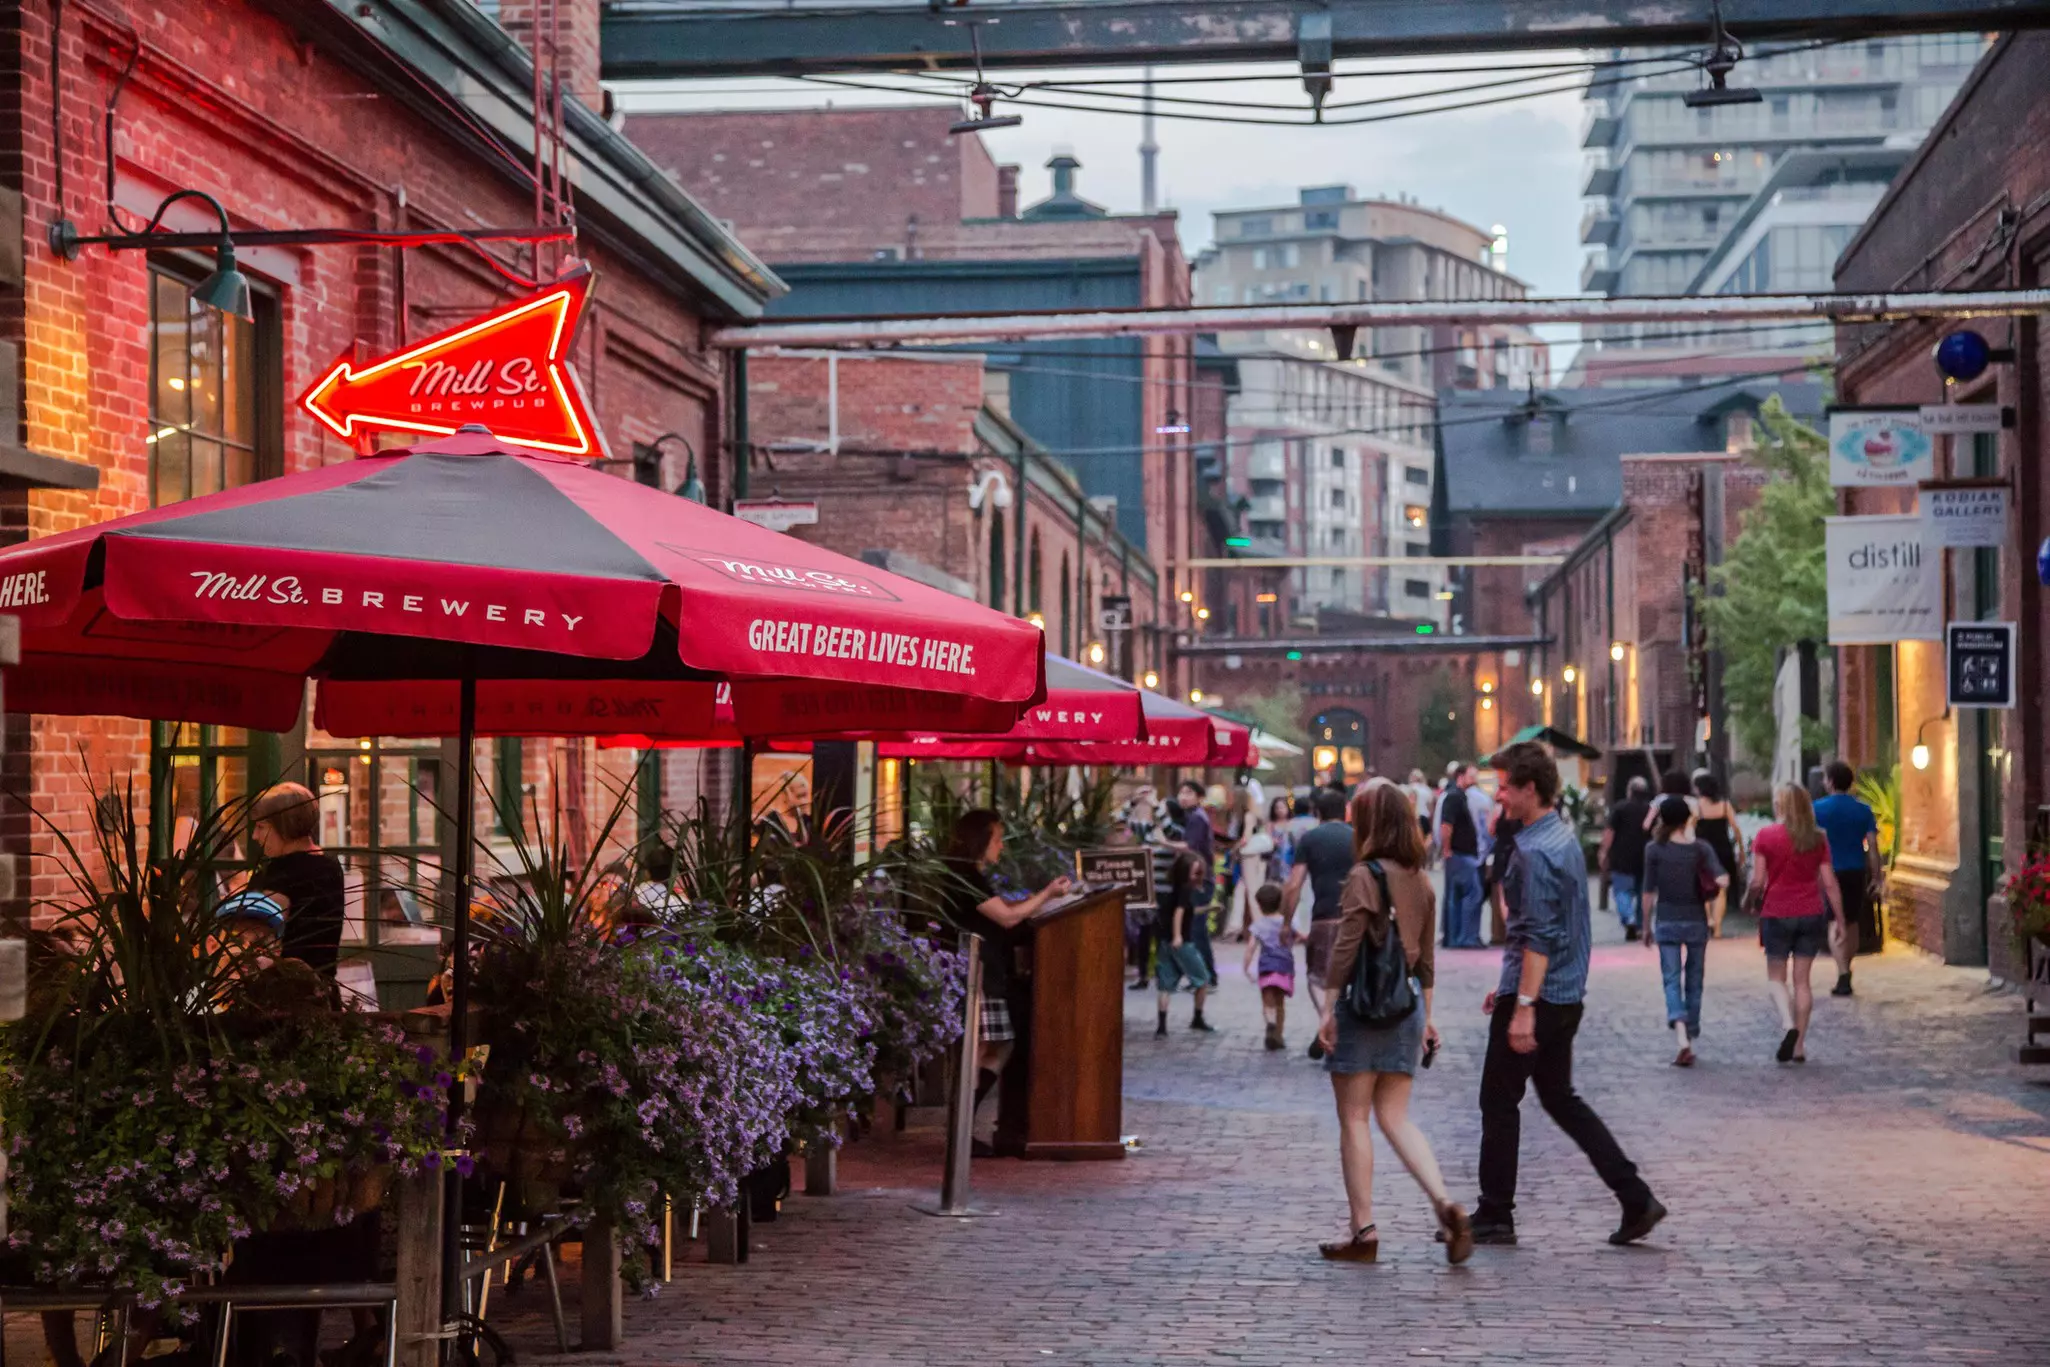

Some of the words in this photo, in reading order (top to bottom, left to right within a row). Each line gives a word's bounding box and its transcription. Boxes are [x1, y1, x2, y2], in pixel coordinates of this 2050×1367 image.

[401, 359, 494, 396] Mill
[497, 357, 547, 395] St.
[411, 398, 545, 413] BREWPUB
[1932, 504, 2001, 518] GALLERY
[701, 558, 805, 581] Mill
[1848, 541, 1921, 570] distill
[0, 570, 50, 608] HERE.
[190, 571, 267, 600] Mill
[267, 576, 308, 605] St.
[322, 588, 583, 631] BREWERY
[748, 618, 813, 655] GREAT
[813, 625, 866, 660] BEER
[867, 631, 921, 667] LIVES
[921, 638, 976, 675] HERE.
[1115, 869, 1130, 880] to
